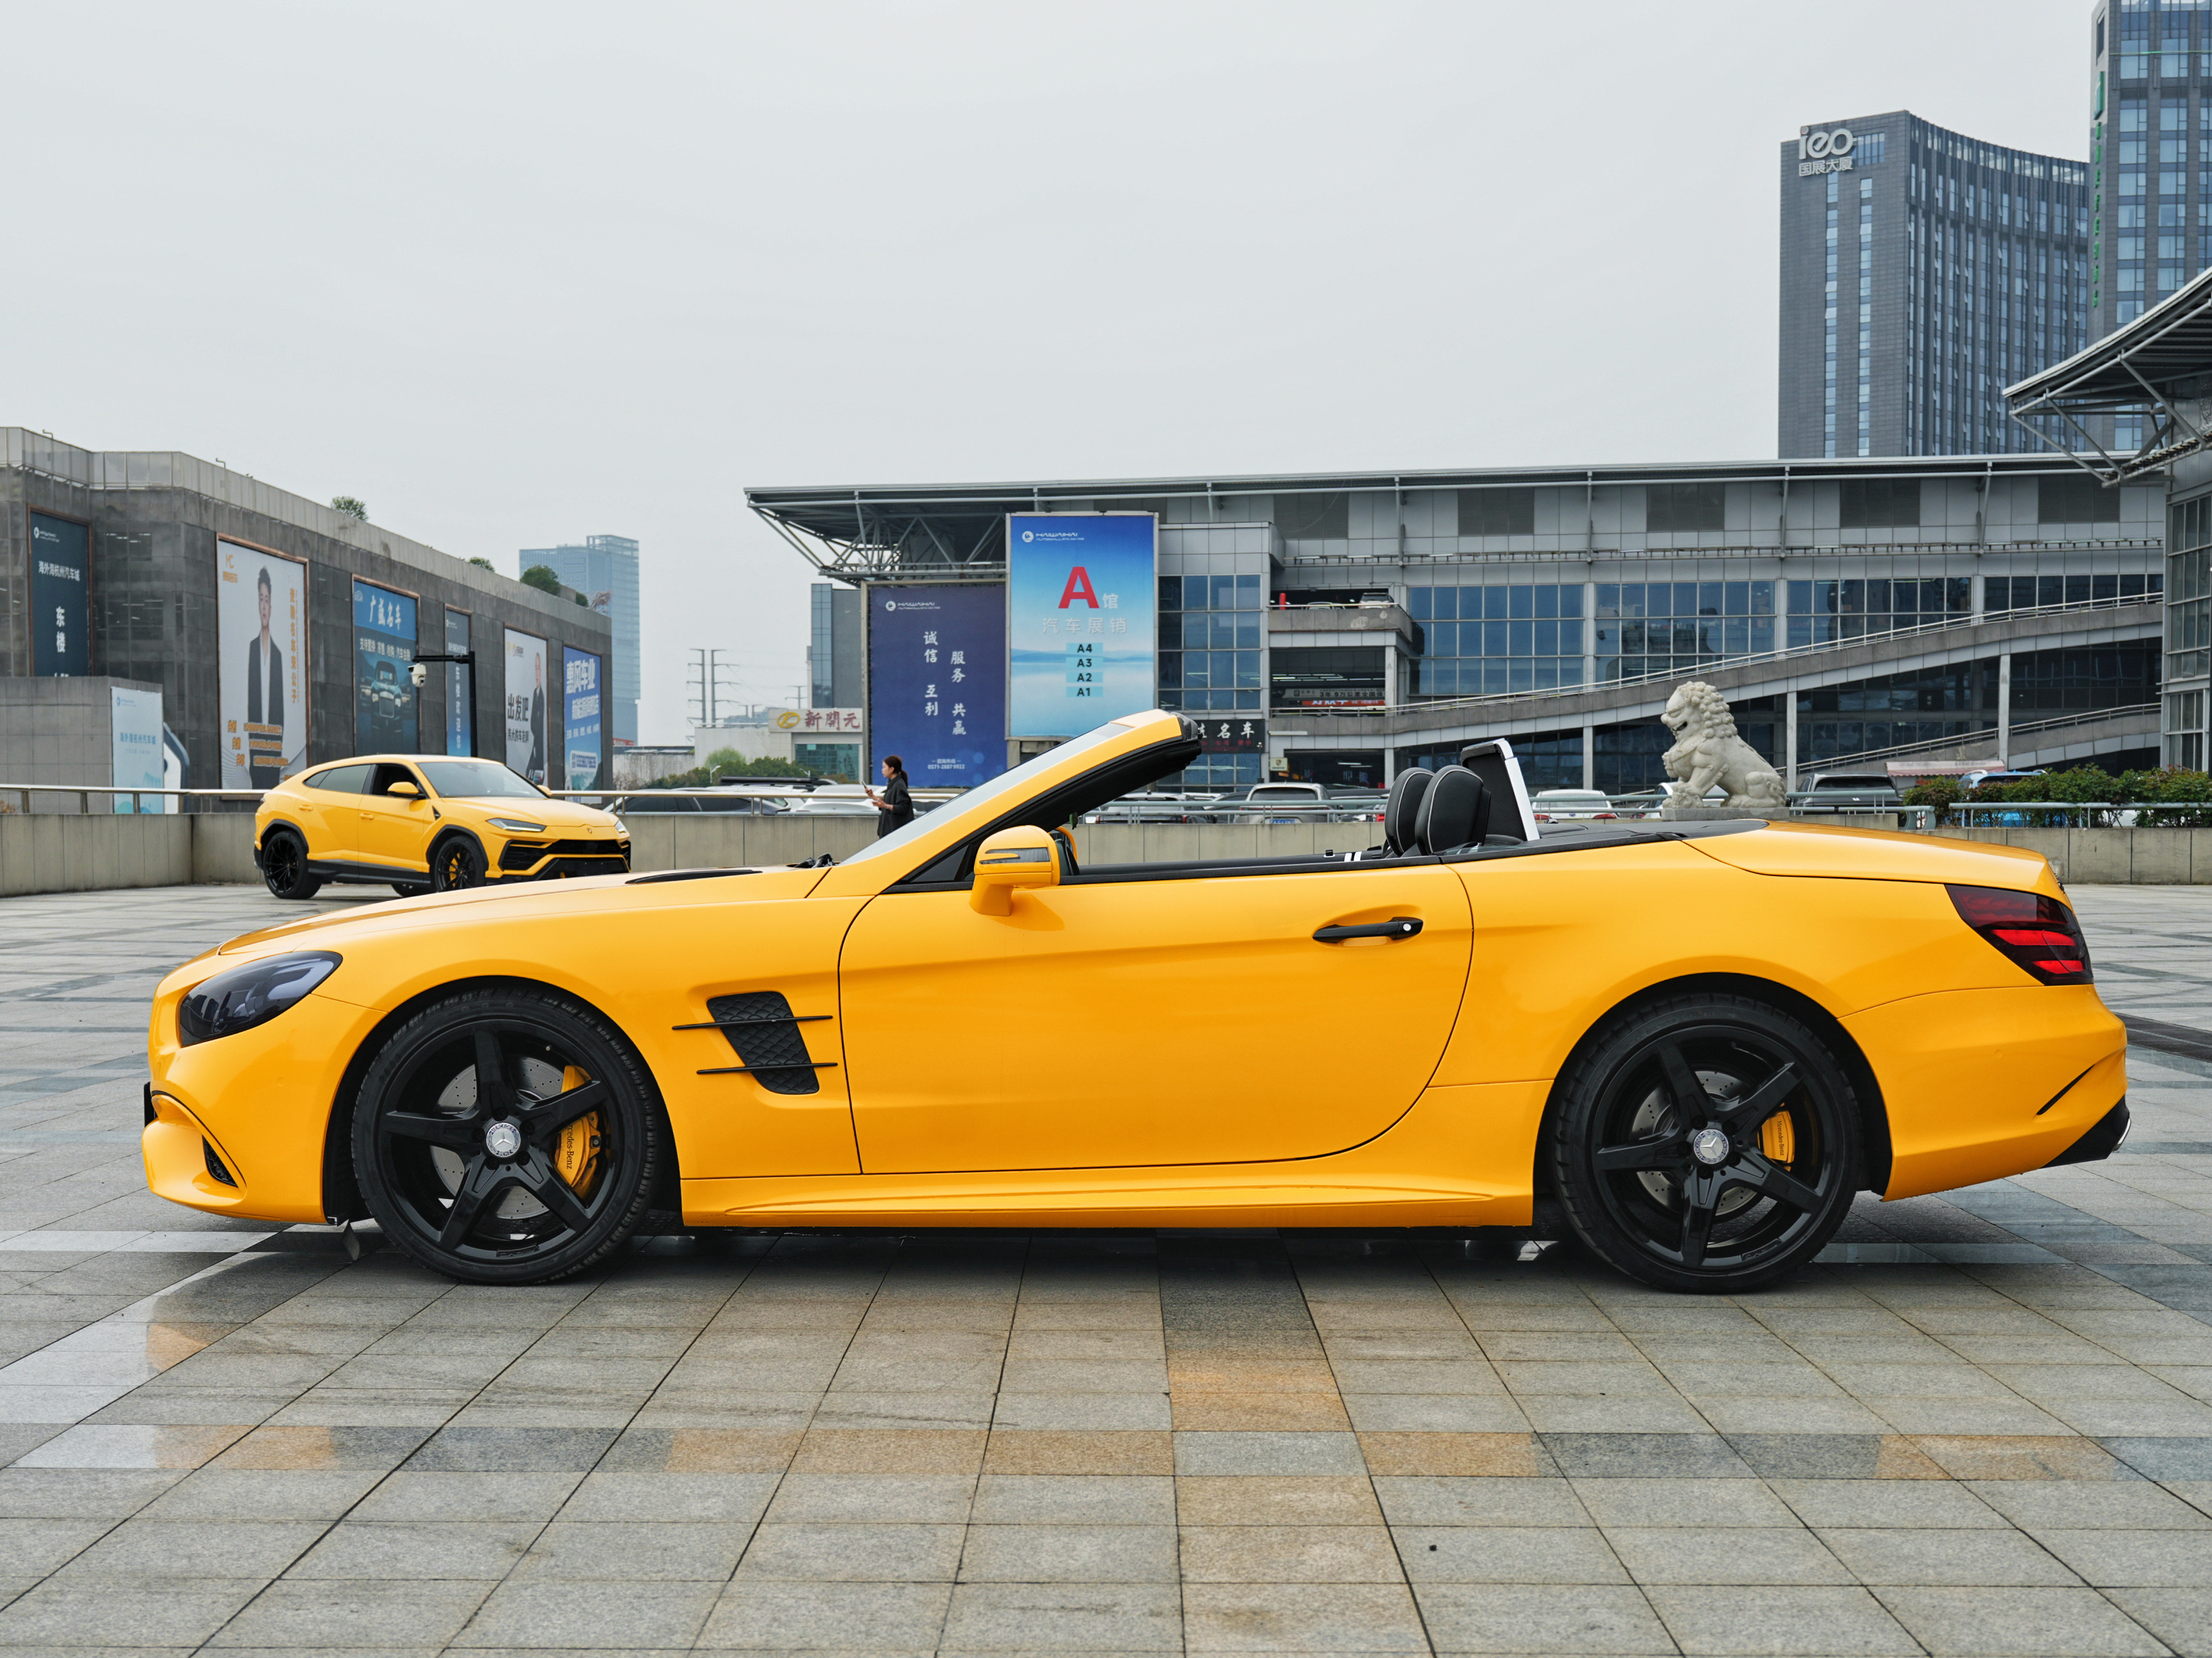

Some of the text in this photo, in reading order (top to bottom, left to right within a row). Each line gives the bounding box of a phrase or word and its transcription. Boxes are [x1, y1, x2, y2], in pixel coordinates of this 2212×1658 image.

[1799, 156, 1853, 177] 国展大厦
[38, 560, 80, 582] 海外海杭州汽车城
[56, 606, 65, 653] 东楼
[1042, 617, 1127, 634] 汽车展销
[1077, 644, 1092, 653] A4
[1077, 658, 1092, 667] A3
[924, 631, 938, 716] 诚信 互利
[1077, 673, 1092, 682] A2
[950, 651, 966, 735] 服务 共赢
[1077, 688, 1091, 696] A1
[507, 693, 529, 722] 出发吧
[804, 710, 860, 732] 新開元
